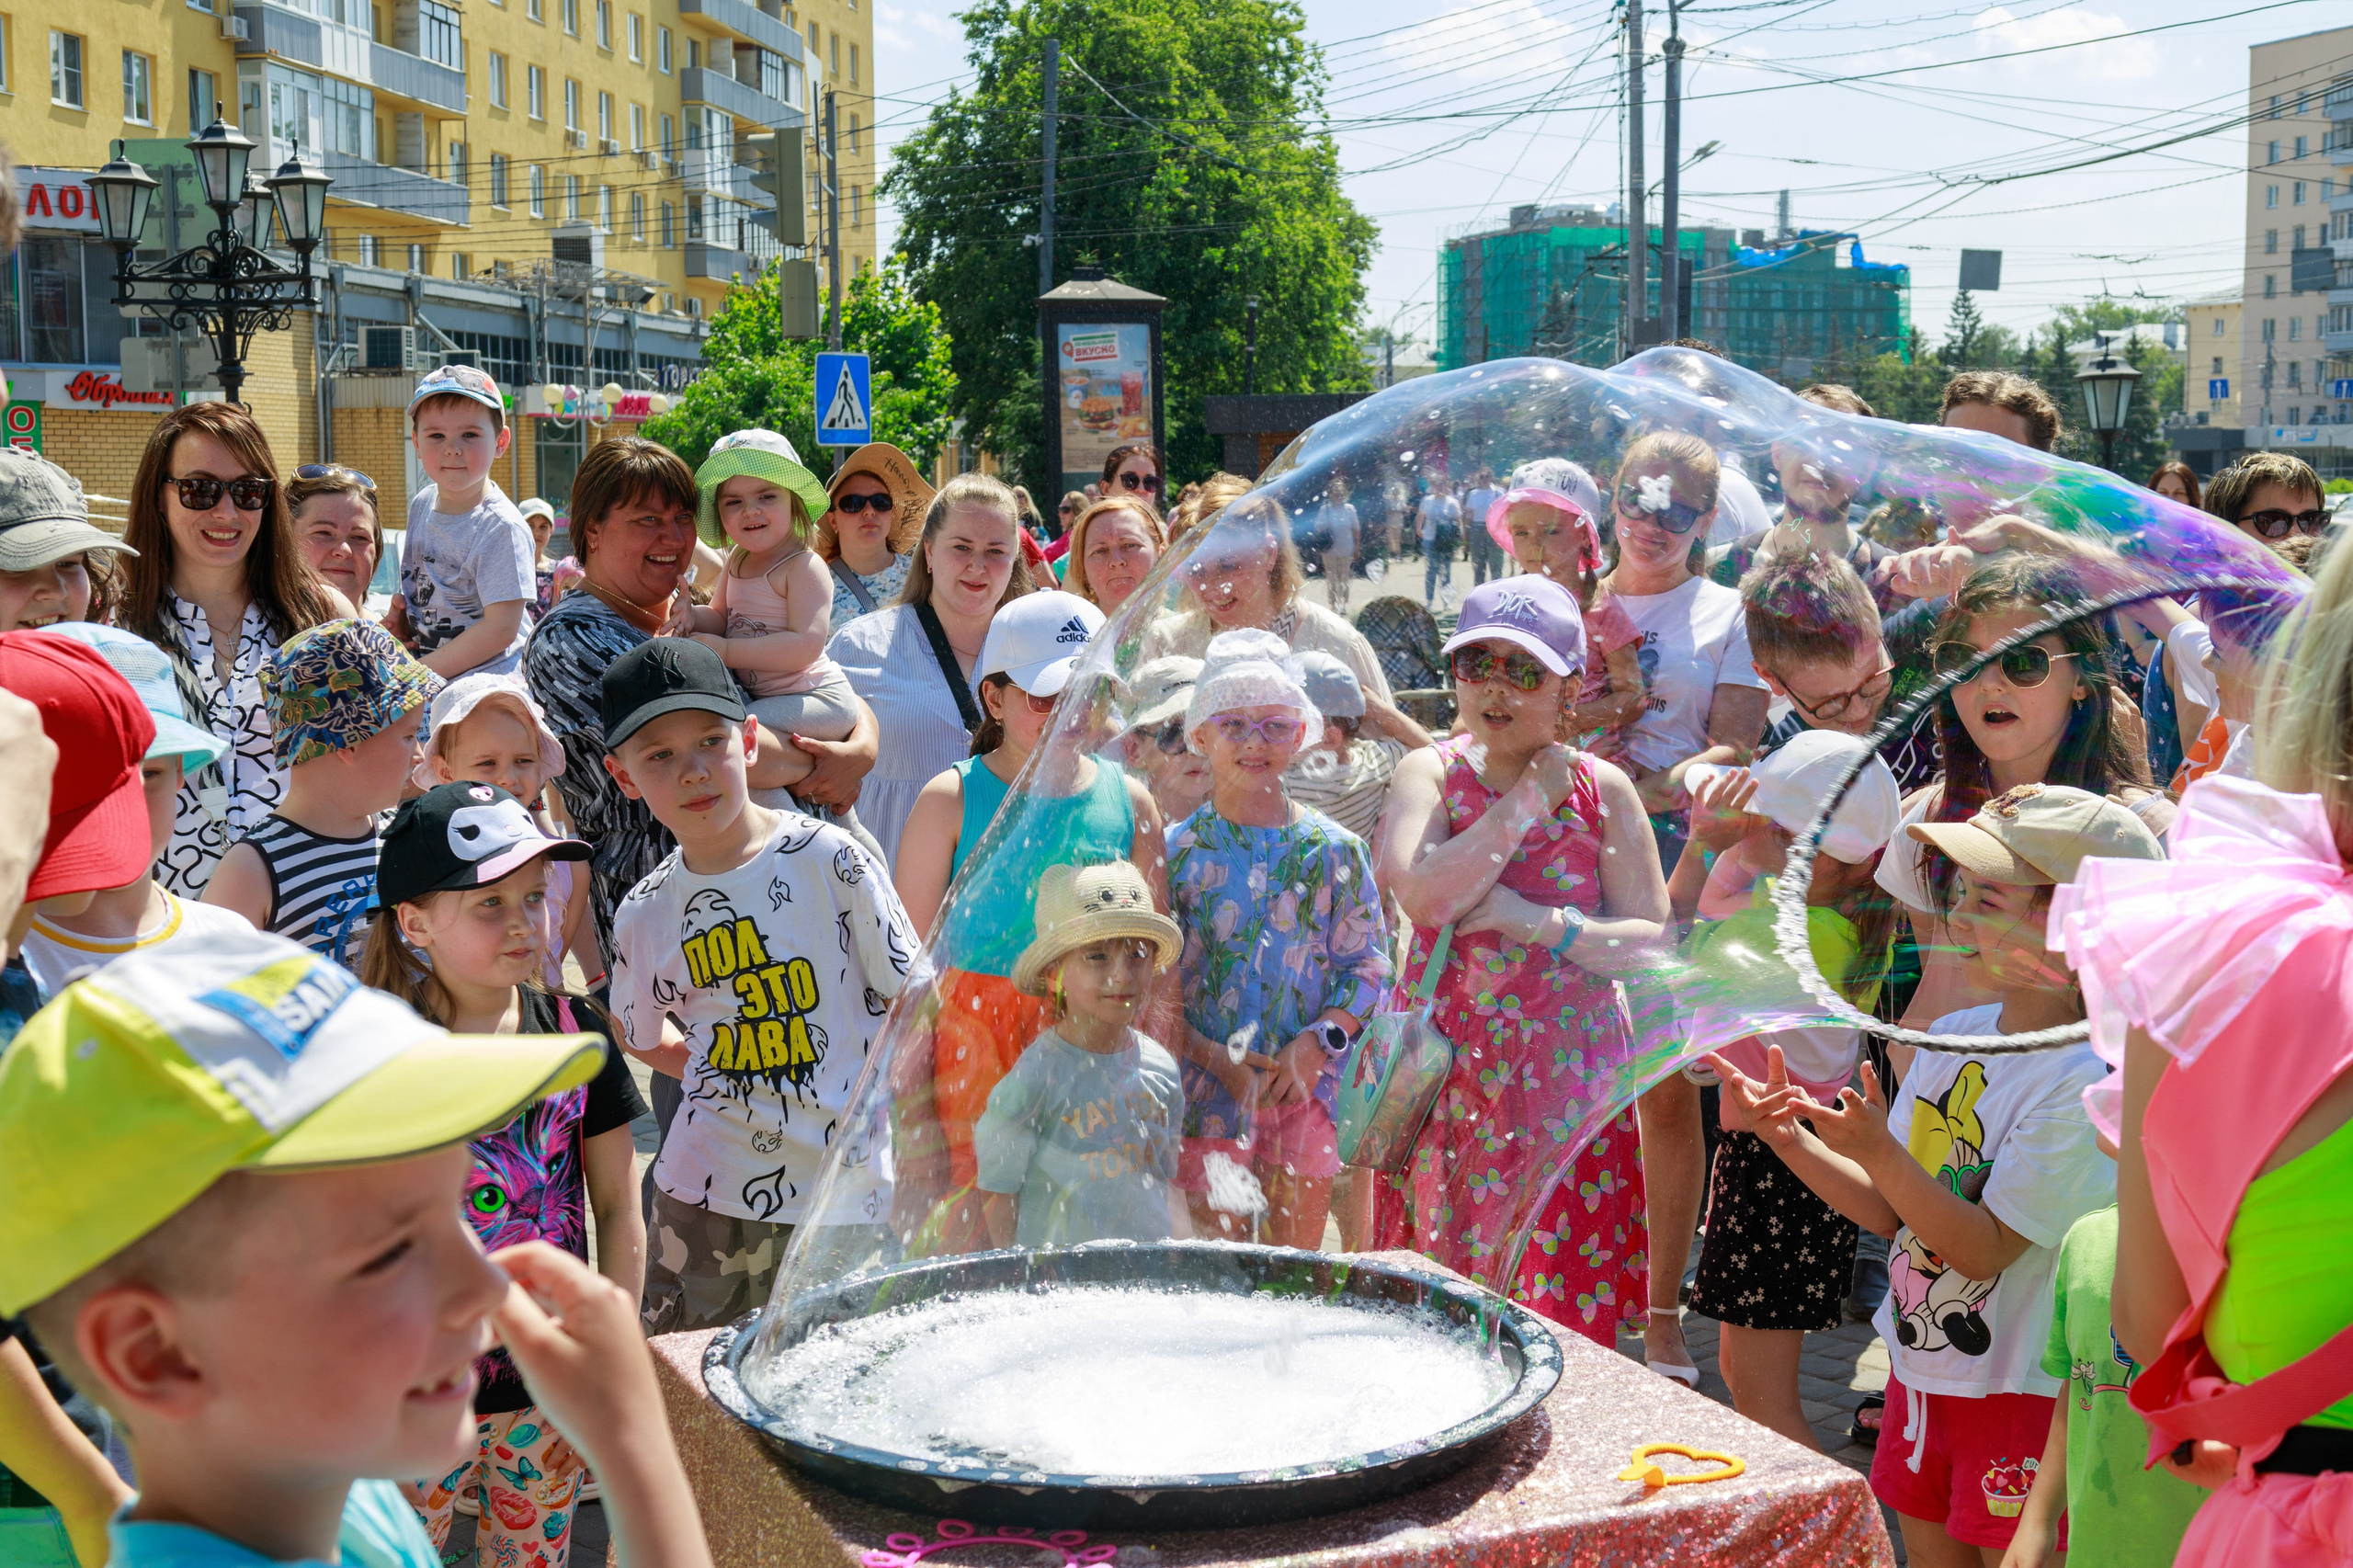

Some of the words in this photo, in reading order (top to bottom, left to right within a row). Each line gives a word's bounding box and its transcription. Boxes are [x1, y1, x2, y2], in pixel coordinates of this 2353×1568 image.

[1075, 345, 1115, 356] ВКУСНО
[683, 918, 767, 988] ПОЛ
[735, 959, 817, 1019] ЭТО
[709, 1015, 816, 1071] ЛАВА
[1062, 1093, 1118, 1140] YAY
